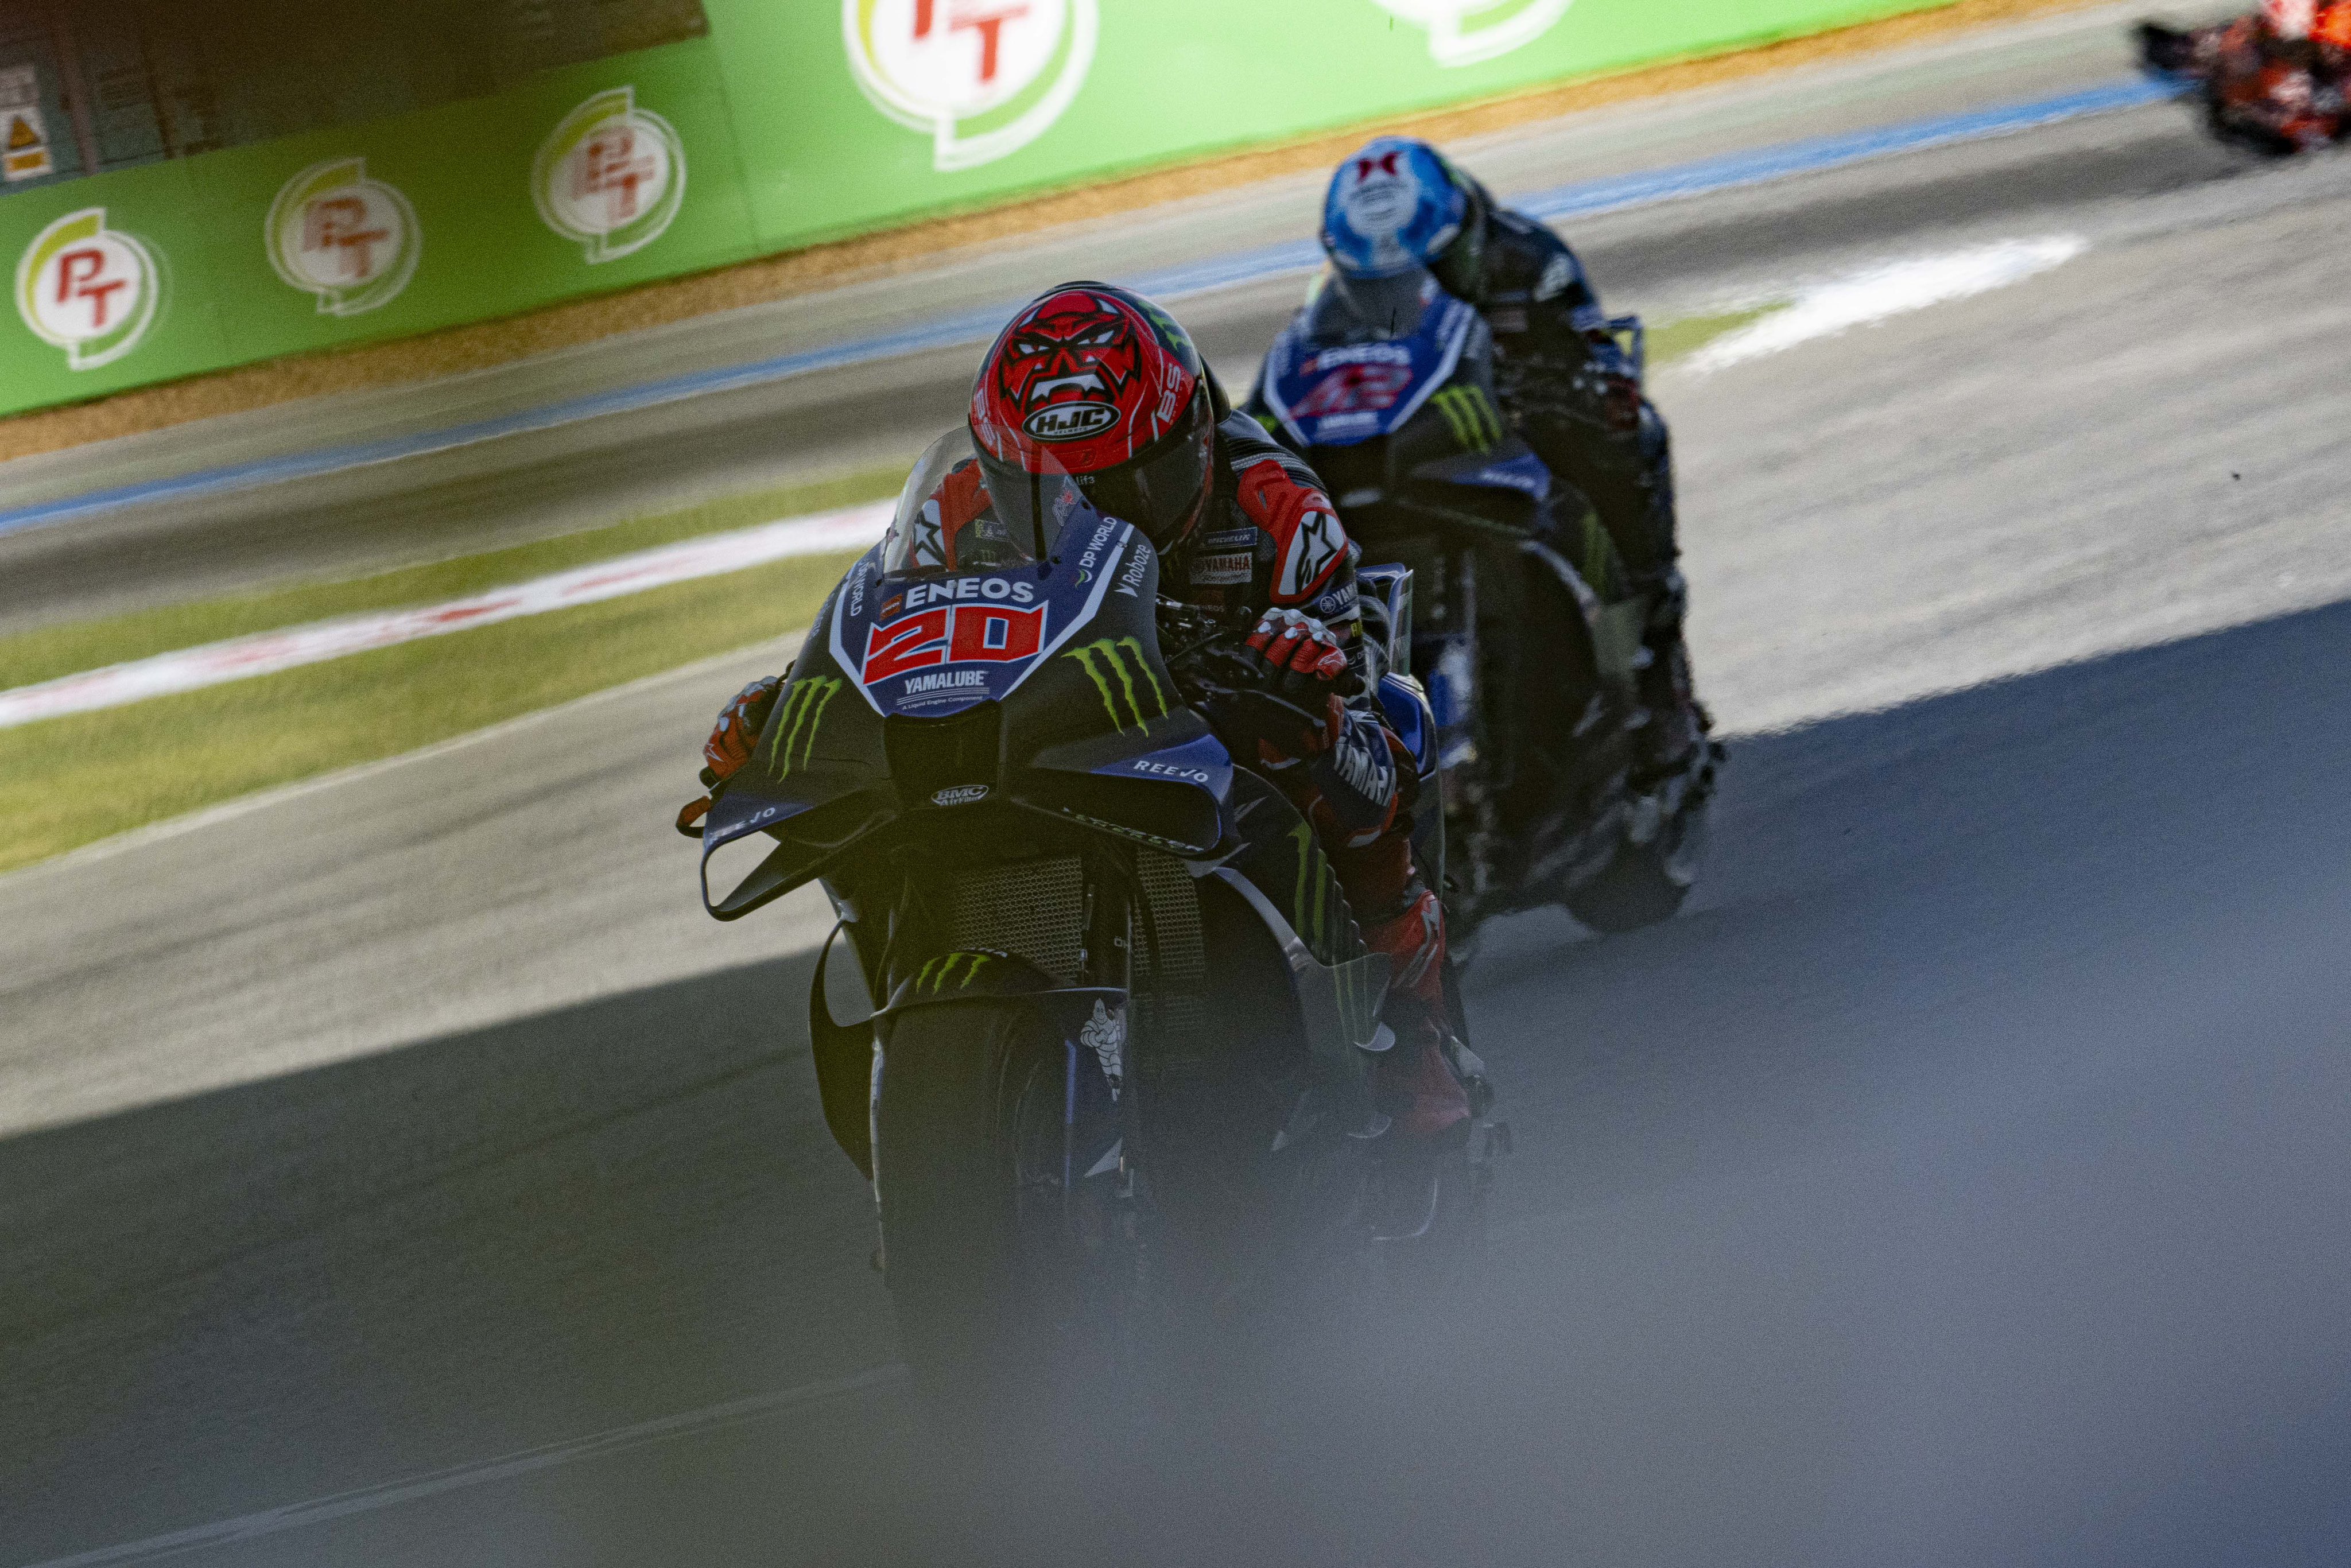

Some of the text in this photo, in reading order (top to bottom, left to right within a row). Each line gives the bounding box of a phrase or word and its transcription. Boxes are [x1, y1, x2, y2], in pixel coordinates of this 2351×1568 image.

[58, 249, 127, 328] PT
[1036, 407, 1107, 434] HJC
[1079, 517, 1118, 568] DP WORLD
[1122, 544, 1152, 587] Roboze
[905, 577, 1034, 610] ENEOS
[863, 600, 1049, 686] 20
[905, 670, 985, 694] YAMALUBE
[908, 701, 926, 709] Liquid
[1133, 760, 1209, 783] REEJO
[937, 786, 983, 799] BMC
